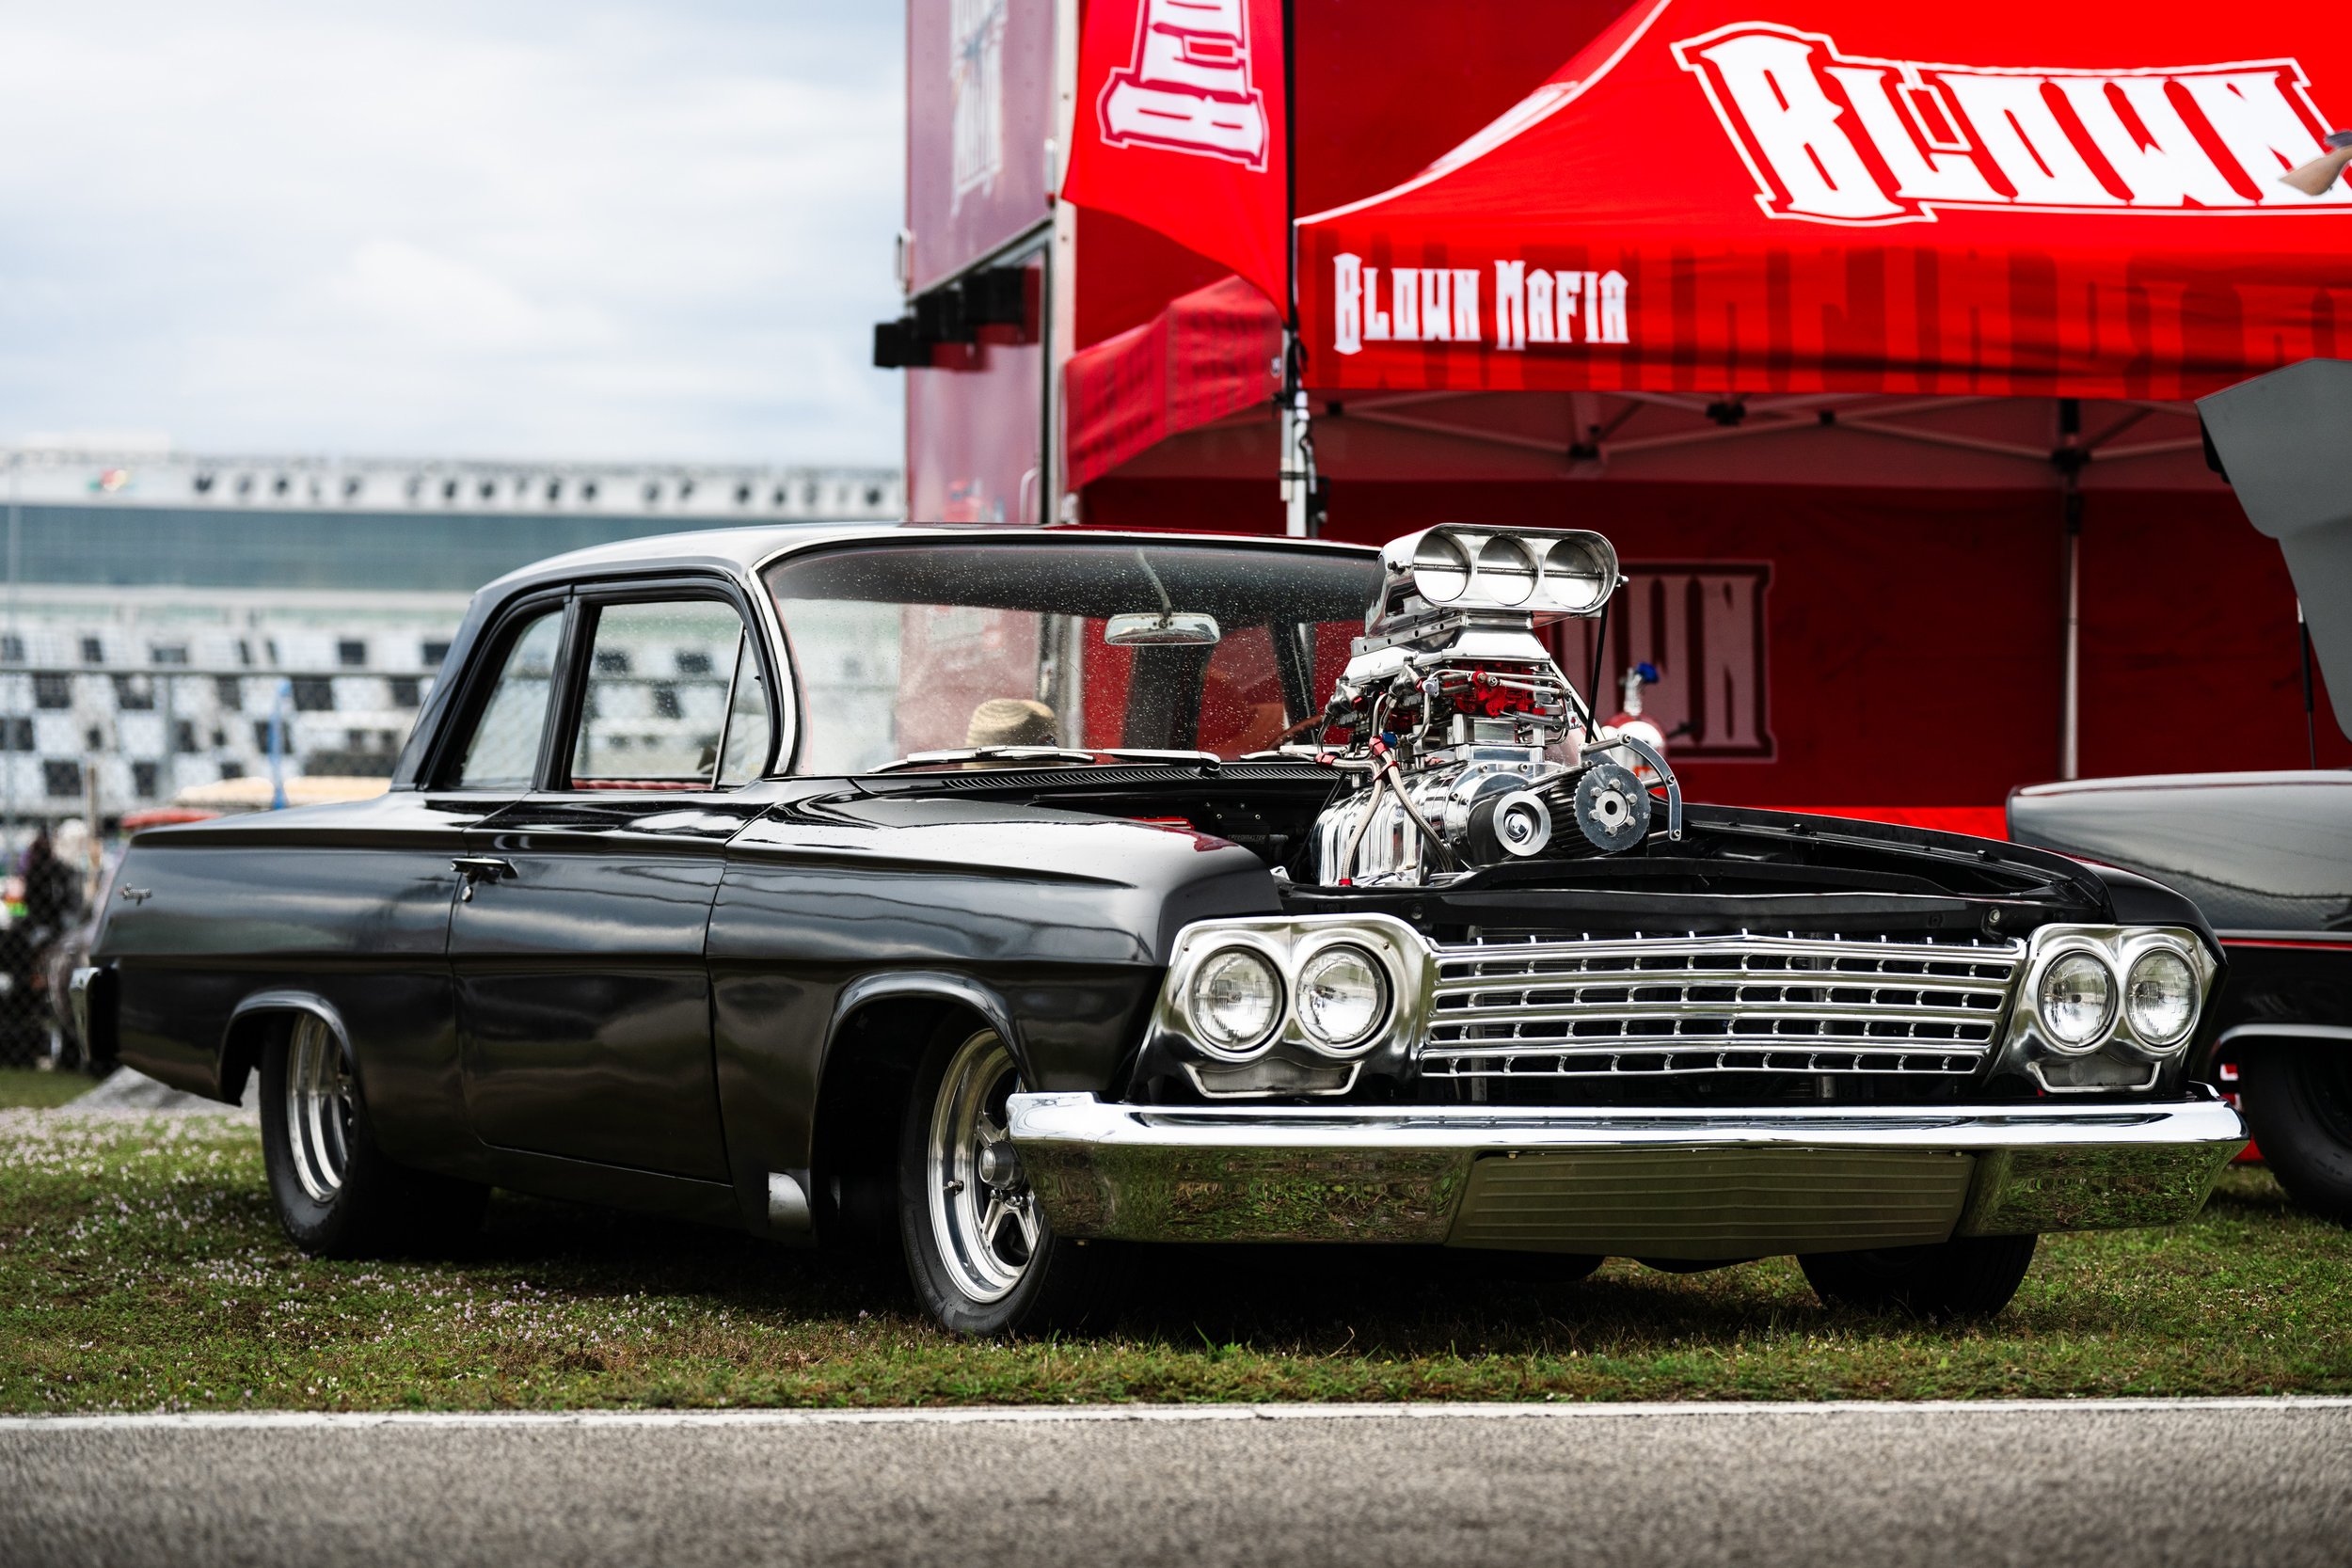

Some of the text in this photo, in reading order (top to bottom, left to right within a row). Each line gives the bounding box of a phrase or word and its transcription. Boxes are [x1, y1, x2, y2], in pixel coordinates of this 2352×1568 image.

[1673, 23, 2352, 224] BLOWN
[1332, 252, 1630, 356] BLOWN MAFIA
